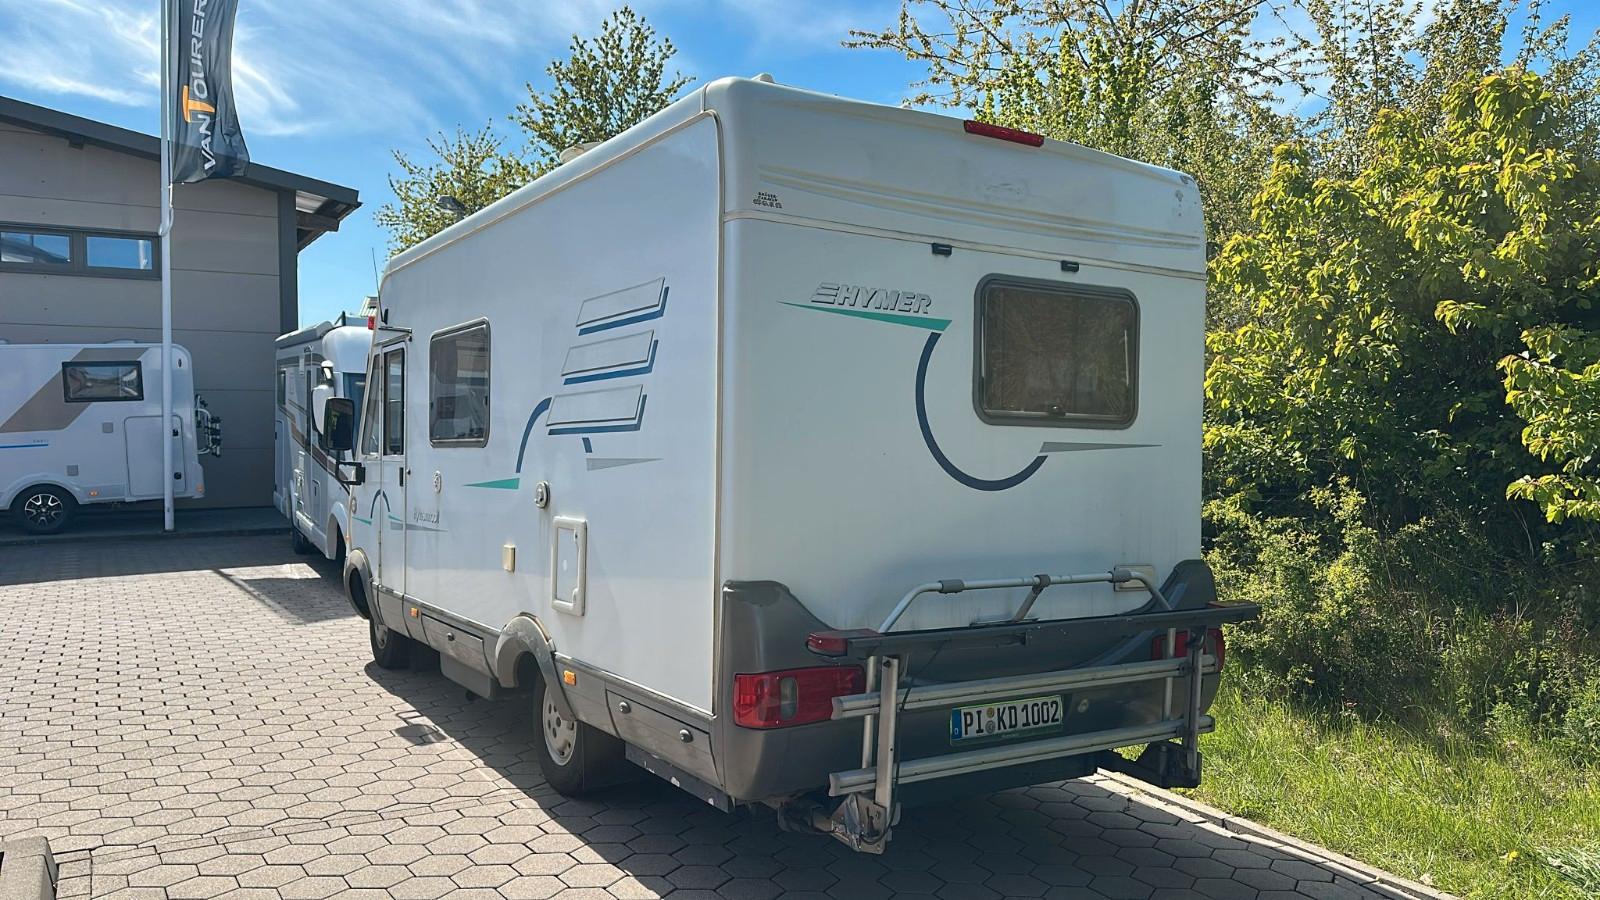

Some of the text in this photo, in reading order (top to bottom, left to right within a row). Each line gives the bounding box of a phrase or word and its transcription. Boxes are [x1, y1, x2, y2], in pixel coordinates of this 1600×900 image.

[963, 700, 1060, 736] PI KD 1002
